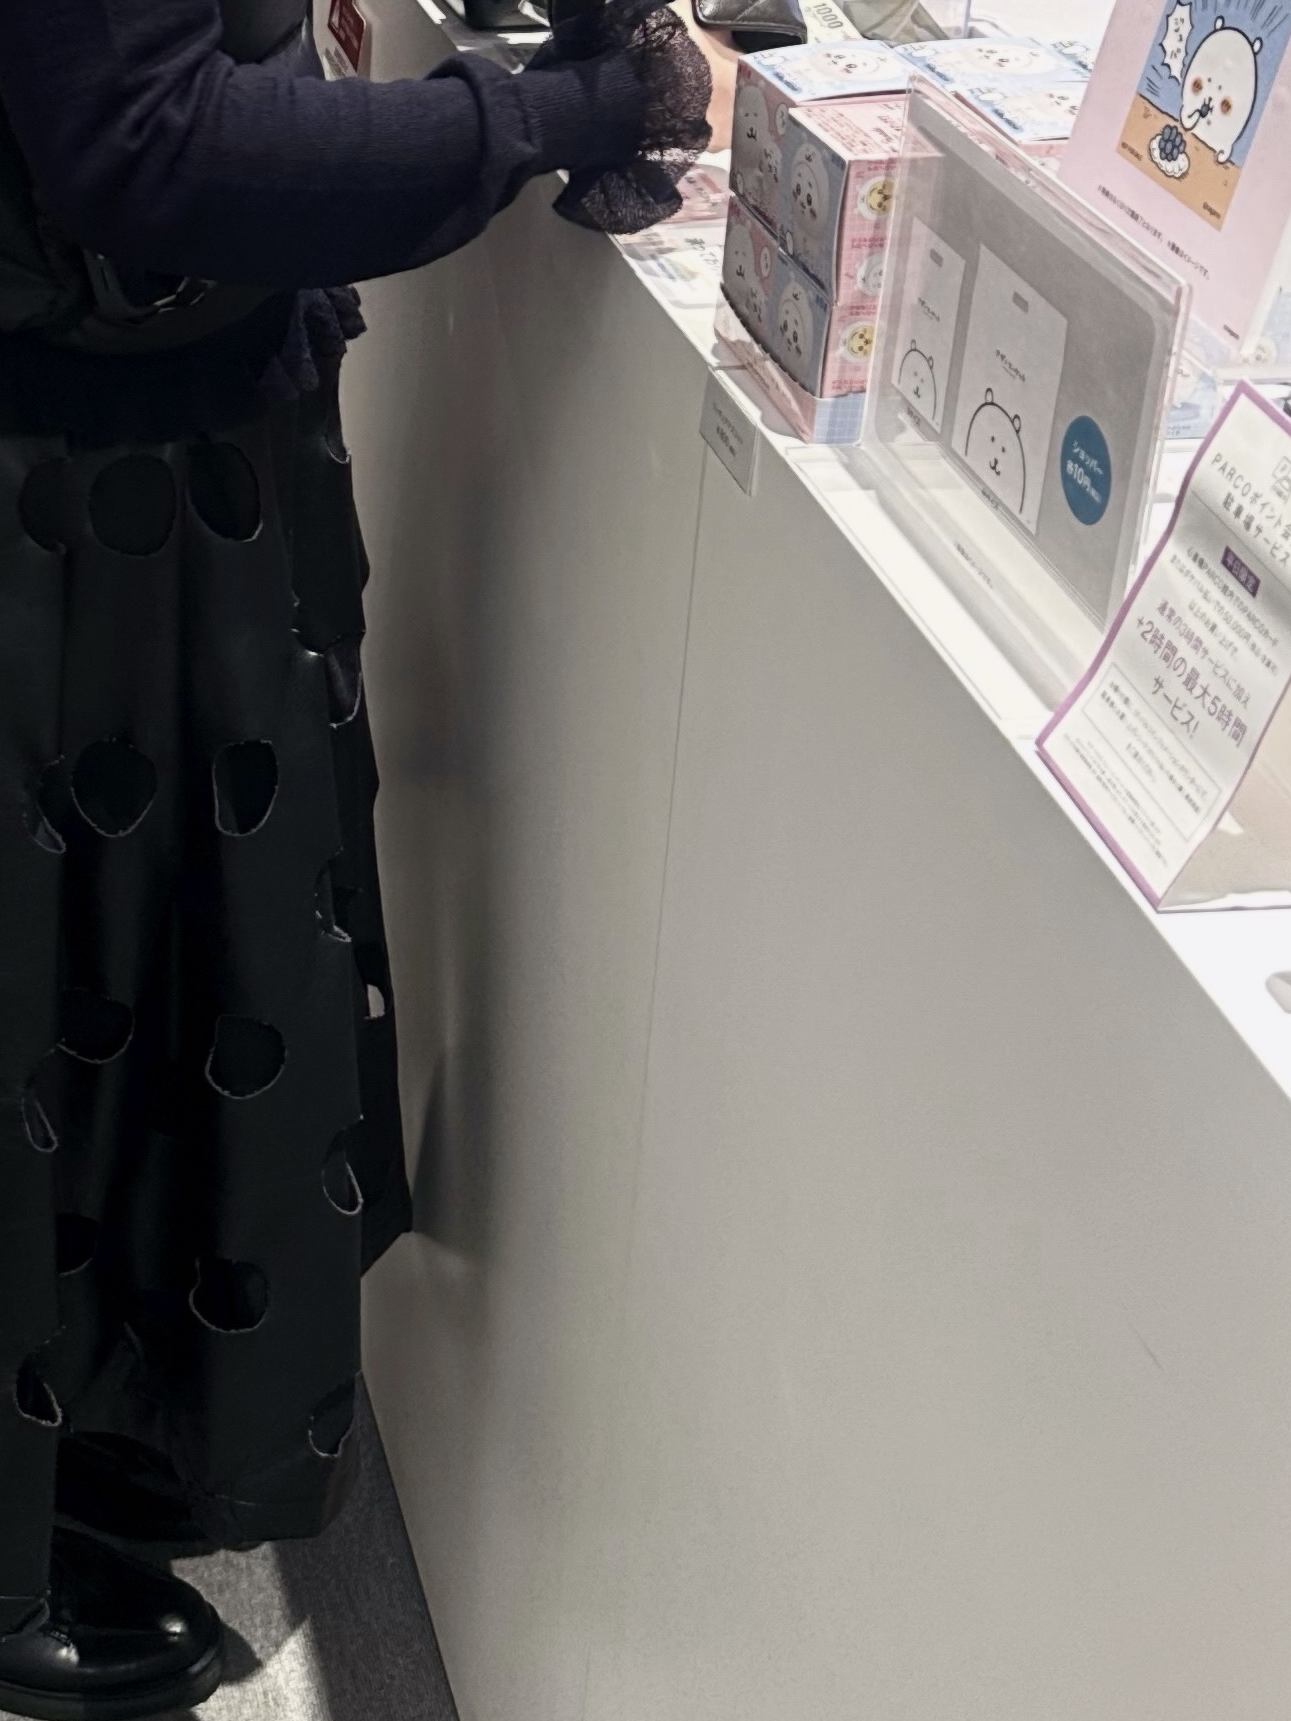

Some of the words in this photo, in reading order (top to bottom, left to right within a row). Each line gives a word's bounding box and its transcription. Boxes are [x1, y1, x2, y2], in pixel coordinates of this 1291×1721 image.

[813, 2, 844, 29] 1000
[1137, 615, 1248, 749] +2時間の最大5時間
